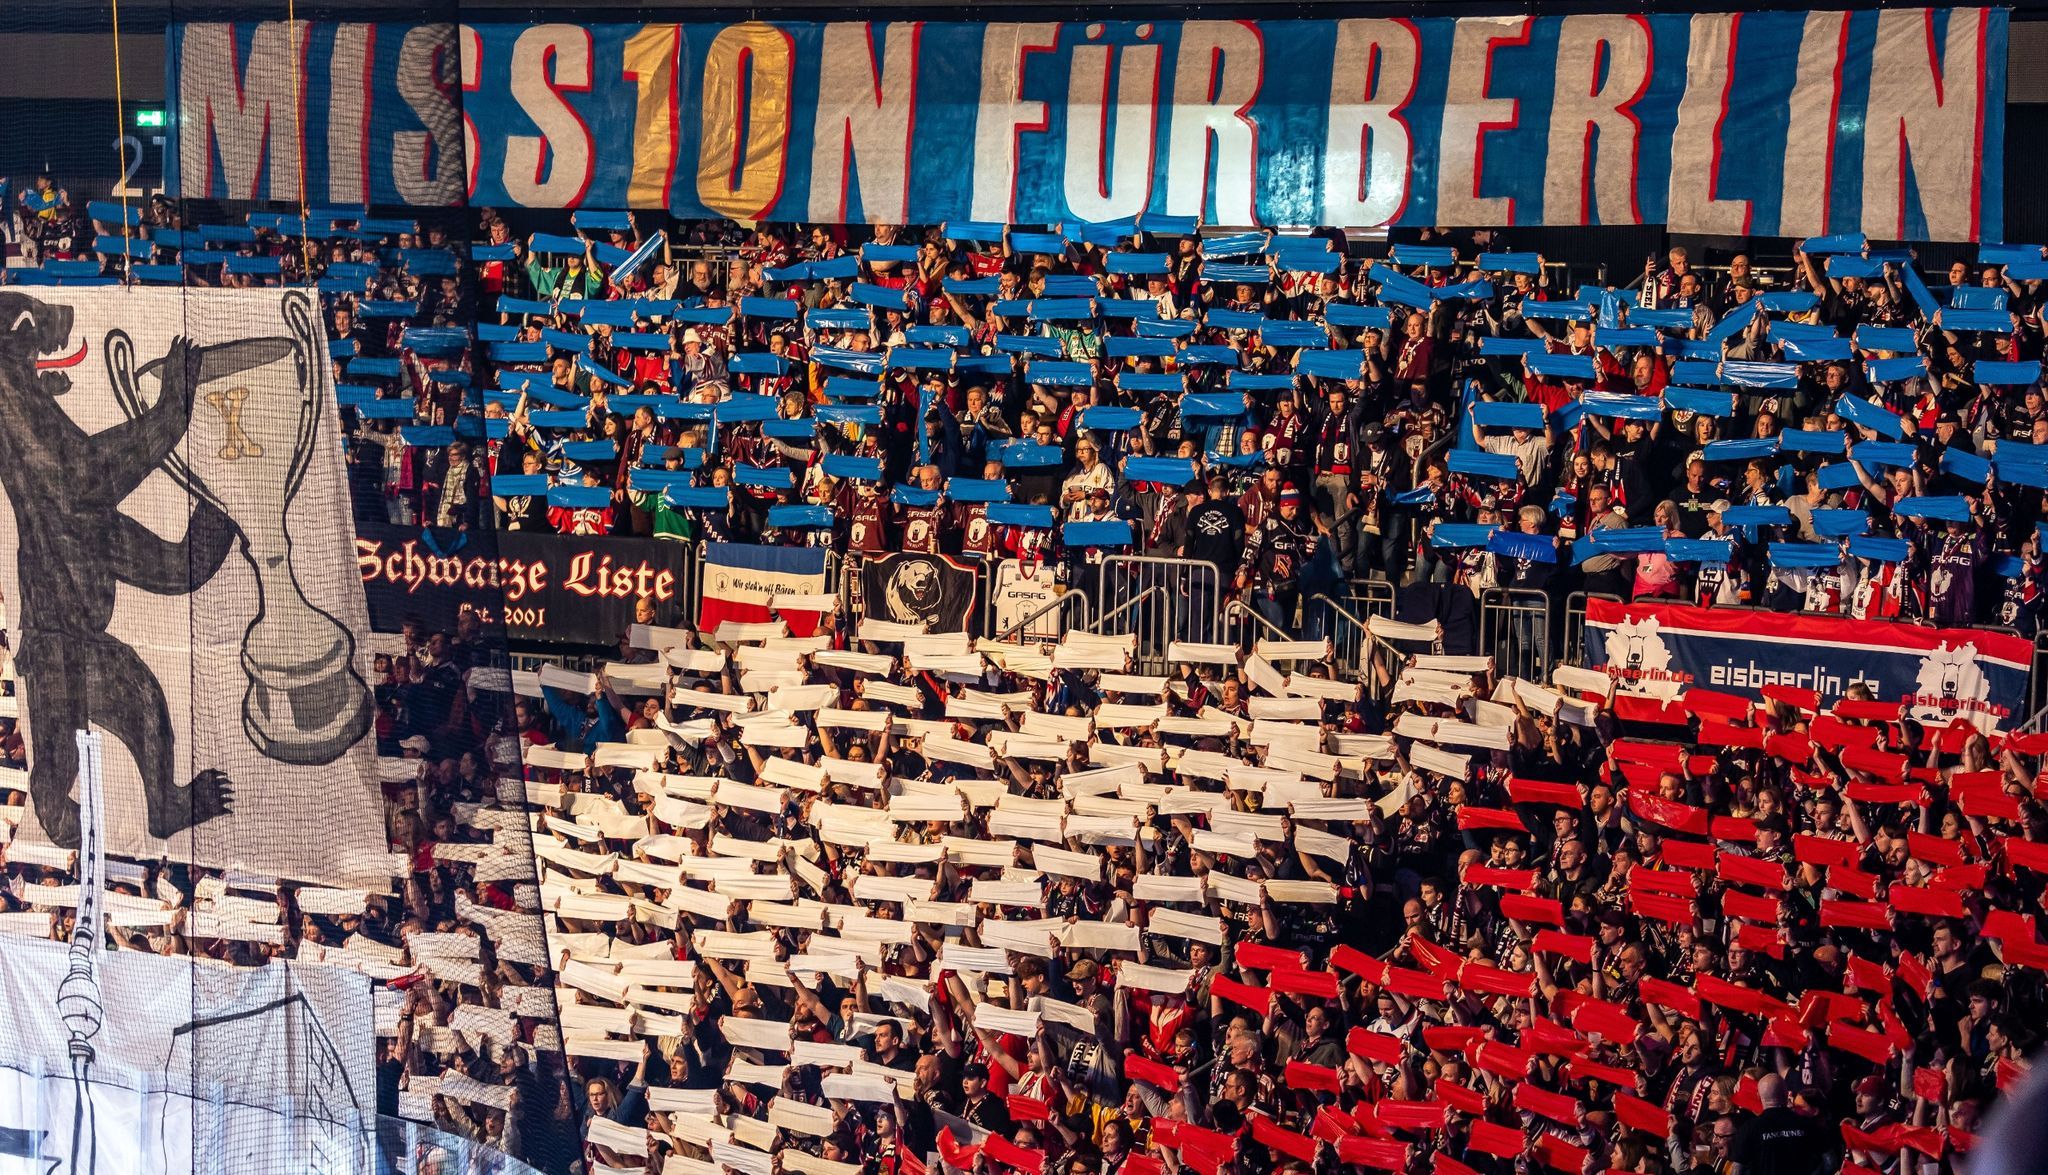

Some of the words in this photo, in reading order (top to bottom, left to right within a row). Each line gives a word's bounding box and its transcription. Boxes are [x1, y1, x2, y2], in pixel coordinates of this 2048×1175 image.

[972, 19, 1265, 226] FÜR
[1324, 8, 1990, 243] BERLIN
[356, 537, 548, 601] Schwarze
[563, 550, 676, 602] Liste
[732, 578, 742, 589] Wir
[1007, 591, 1047, 600] GASAG
[503, 605, 546, 628] 2001
[1901, 692, 2011, 719] eisbaerlin.de
